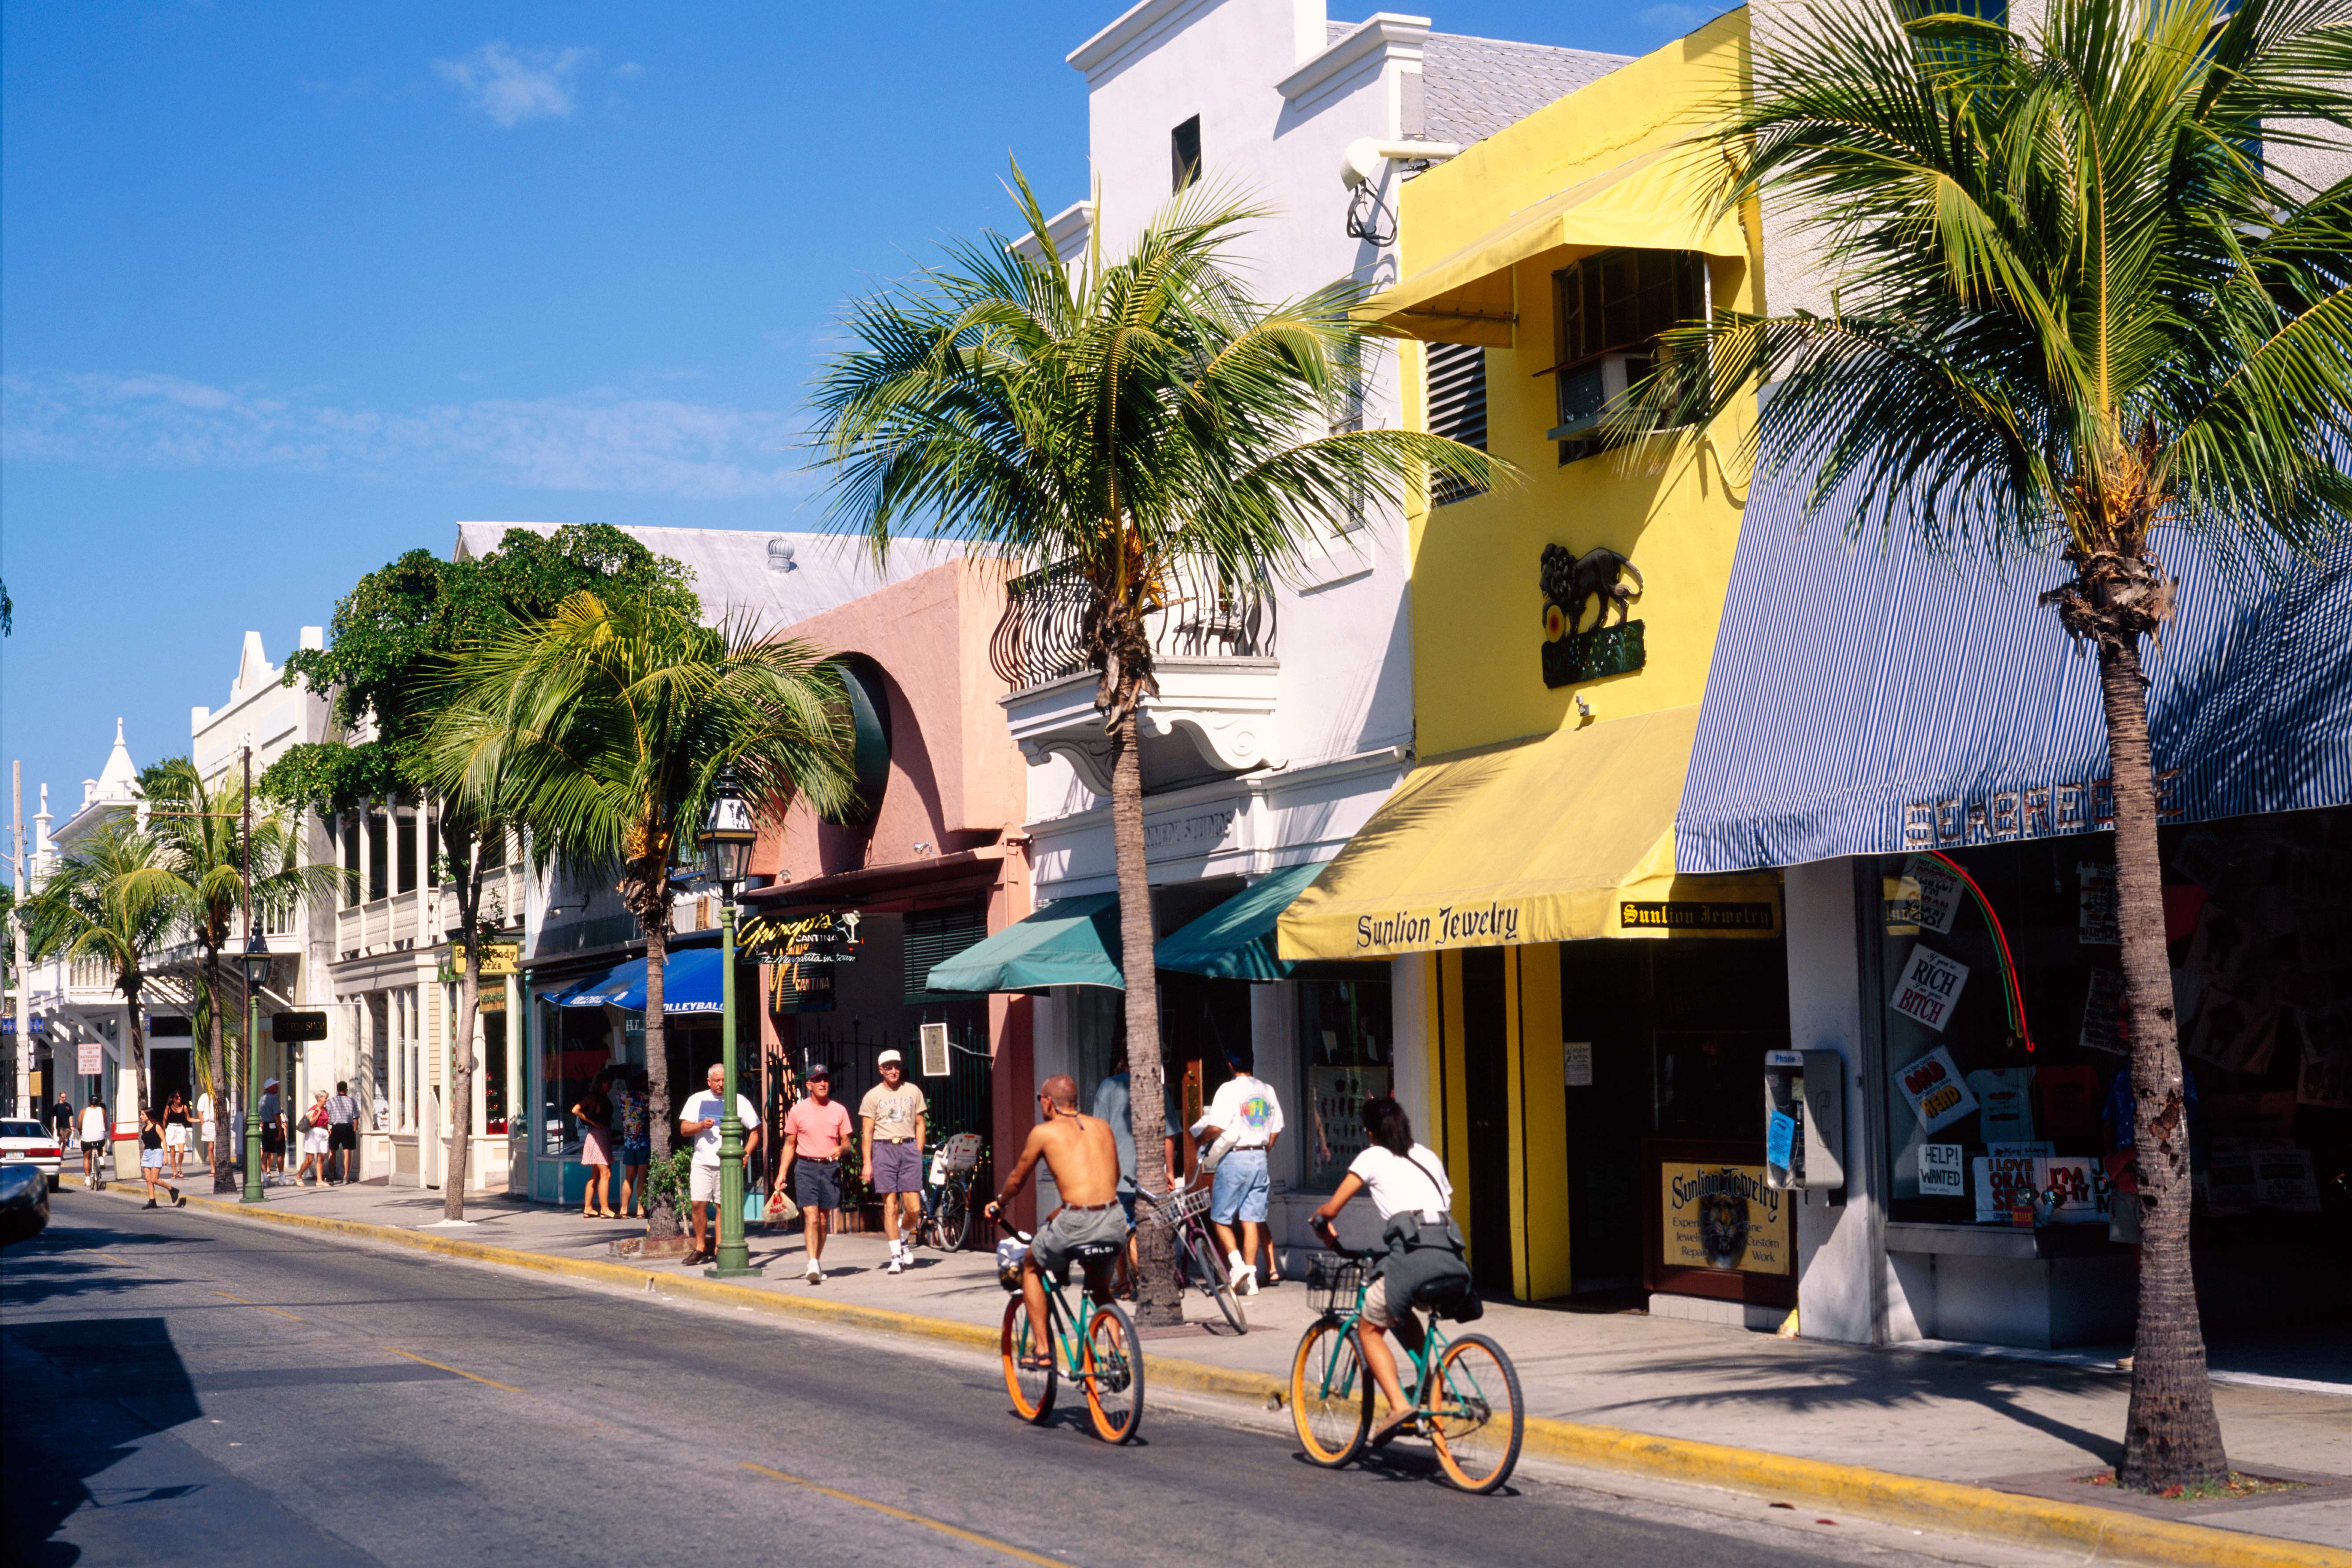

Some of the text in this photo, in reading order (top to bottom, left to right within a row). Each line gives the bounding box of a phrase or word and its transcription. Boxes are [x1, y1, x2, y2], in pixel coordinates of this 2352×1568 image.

[1905, 767, 2183, 847] SEABREEE
[1624, 904, 1770, 928] Sunlion Jewelry
[1357, 900, 1519, 951] Sunlion Jewelry
[736, 913, 832, 957] Gringo's
[480, 960, 502, 970] orks
[774, 953, 821, 964] Margarita
[835, 953, 856, 963] town
[796, 977, 830, 991] CANTINA
[1911, 959, 1959, 997] RICH
[664, 1002, 724, 1011] OLLEYBALL
[1898, 988, 1945, 1024] BITCH
[1775, 1055, 1796, 1063] Phone
[879, 1098, 898, 1109] CAPE
[1919, 1085, 1962, 1119] HEAD
[1926, 1146, 1959, 1166] HELP!
[1988, 1159, 2033, 1171] I LOVE
[1919, 1169, 1960, 1186] WANTED
[1990, 1172, 2032, 1189] ORAL
[1672, 1167, 1779, 1223] Sunlion Jewelry
[1747, 1237, 1779, 1248] Custom
[1752, 1251, 1775, 1262] Work
